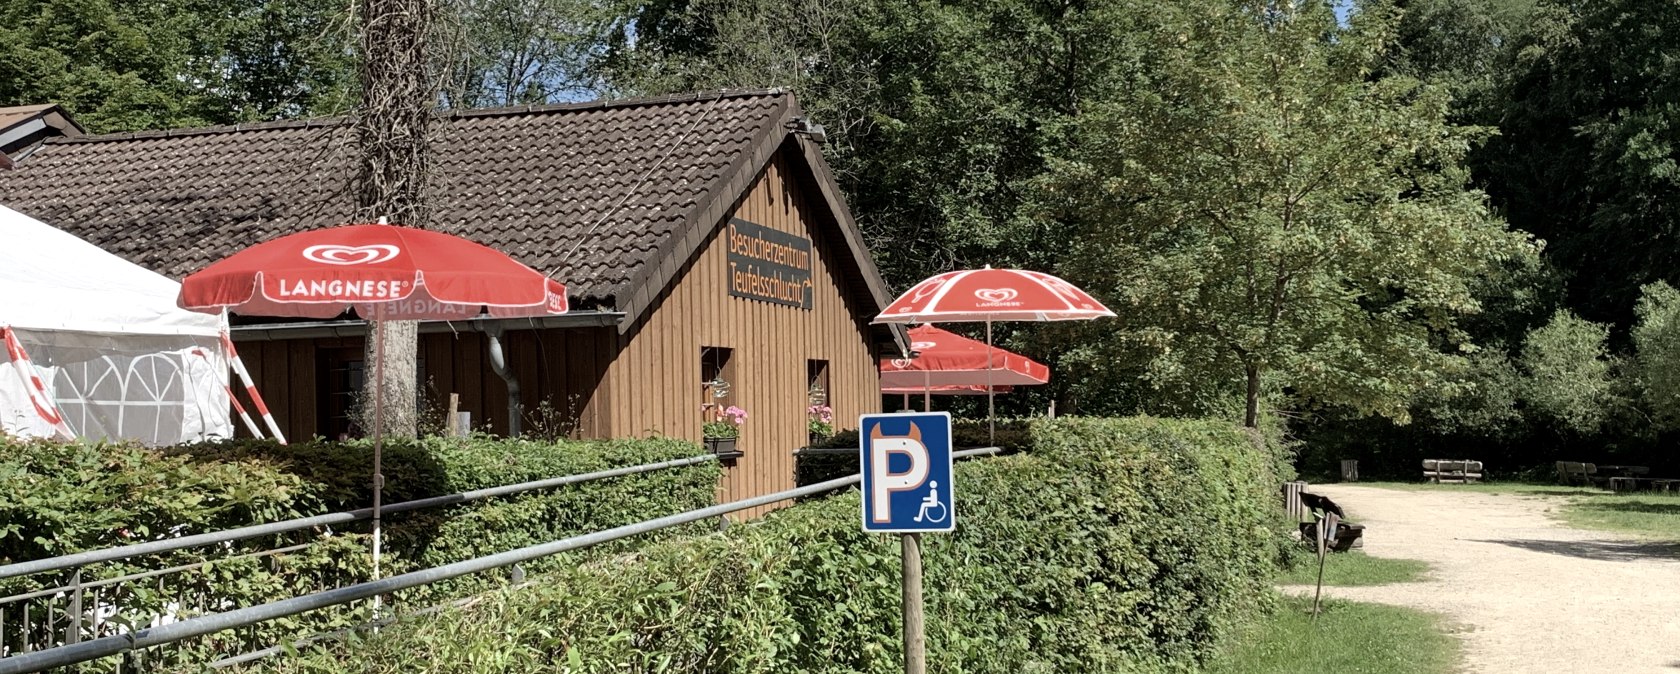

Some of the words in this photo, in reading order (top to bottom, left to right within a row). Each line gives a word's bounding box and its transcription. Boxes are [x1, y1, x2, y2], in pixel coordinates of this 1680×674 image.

[730, 223, 809, 270] Besucherzentrum
[730, 261, 802, 303] Teufelsschlucht
[870, 435, 930, 523] P
